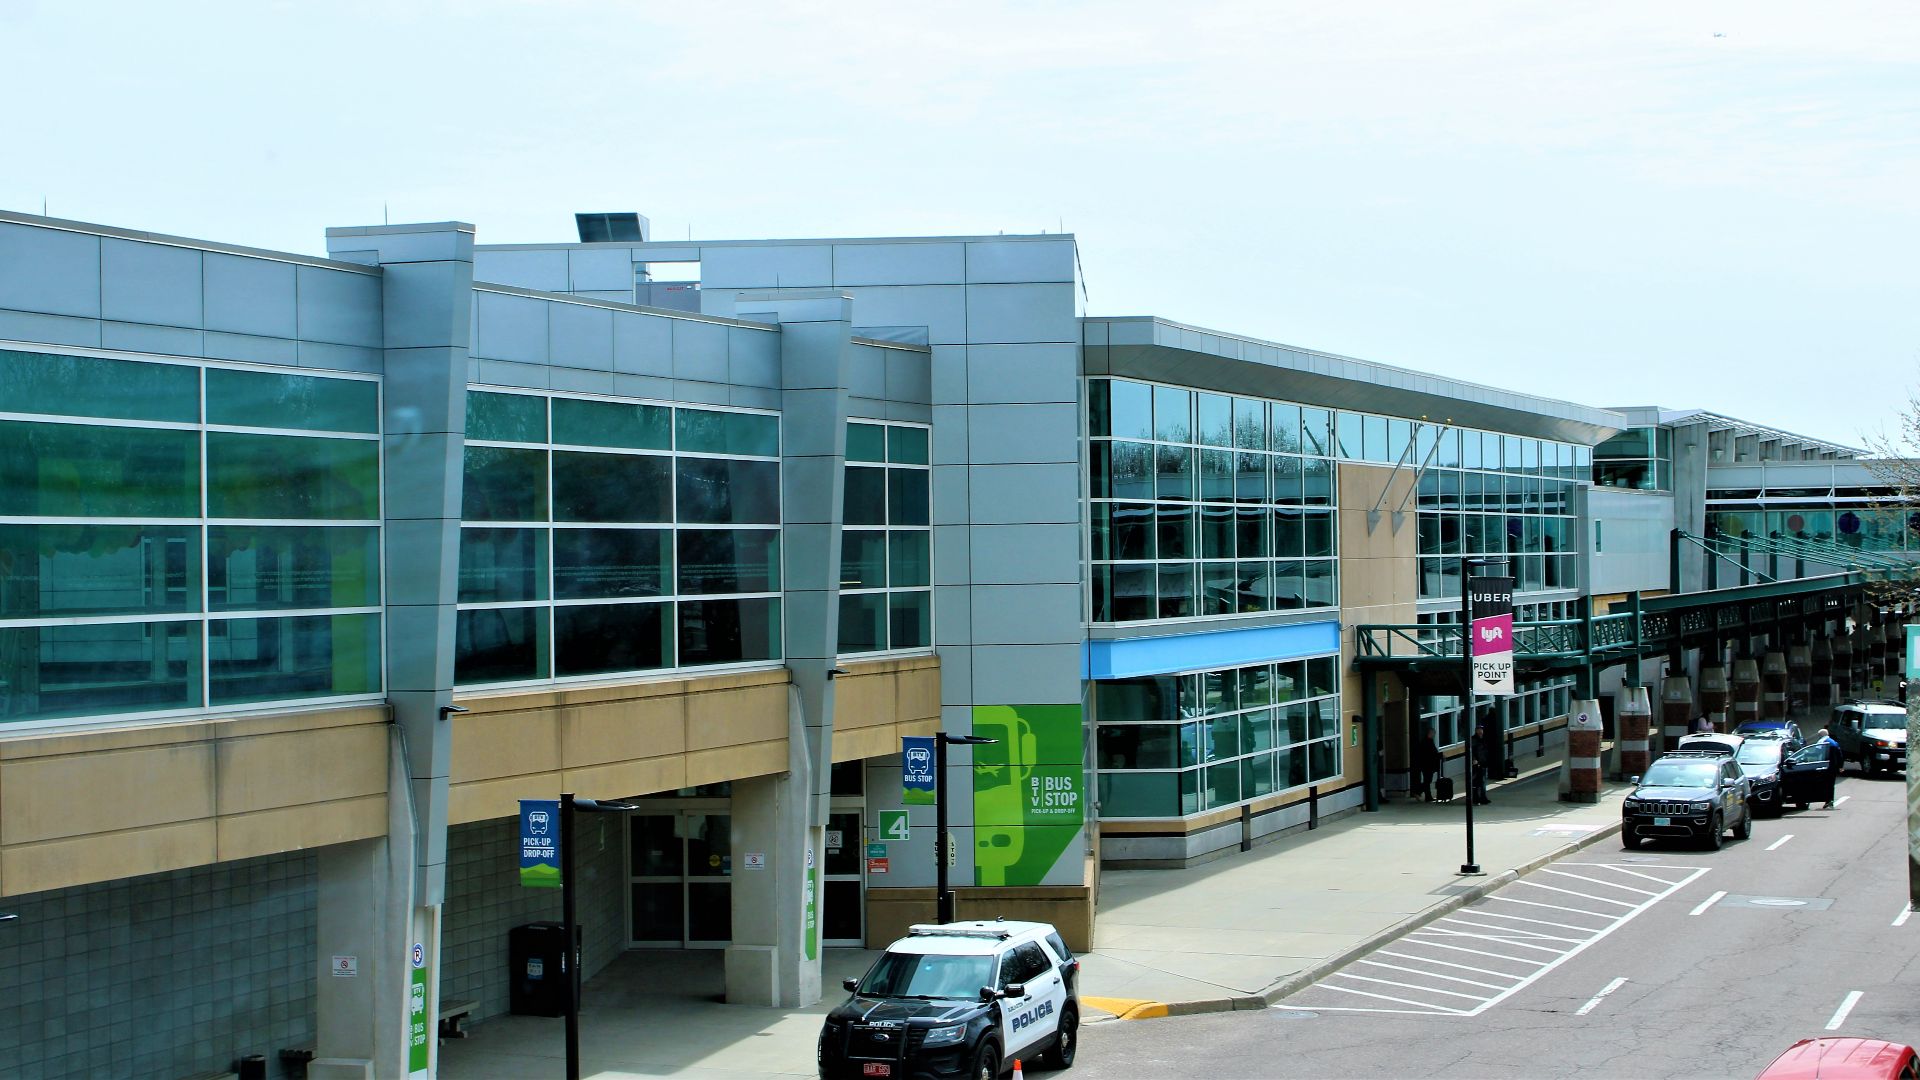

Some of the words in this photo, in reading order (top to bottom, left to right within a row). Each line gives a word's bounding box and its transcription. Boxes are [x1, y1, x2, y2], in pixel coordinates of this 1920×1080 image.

[1474, 593, 1511, 602] UBER
[1481, 627, 1503, 642] lyft
[904, 774, 916, 782] BUS
[1045, 777, 1072, 790] BUS
[1031, 777, 1039, 806] BTV
[1045, 792, 1077, 806] STOP
[888, 816, 909, 840] 4
[523, 837, 551, 846] PICK-UP
[523, 849, 555, 858] DROP-OFF
[1012, 1000, 1054, 1032] POLICE
[414, 1022, 424, 1033] BUS
[414, 1034, 425, 1046] STOP
